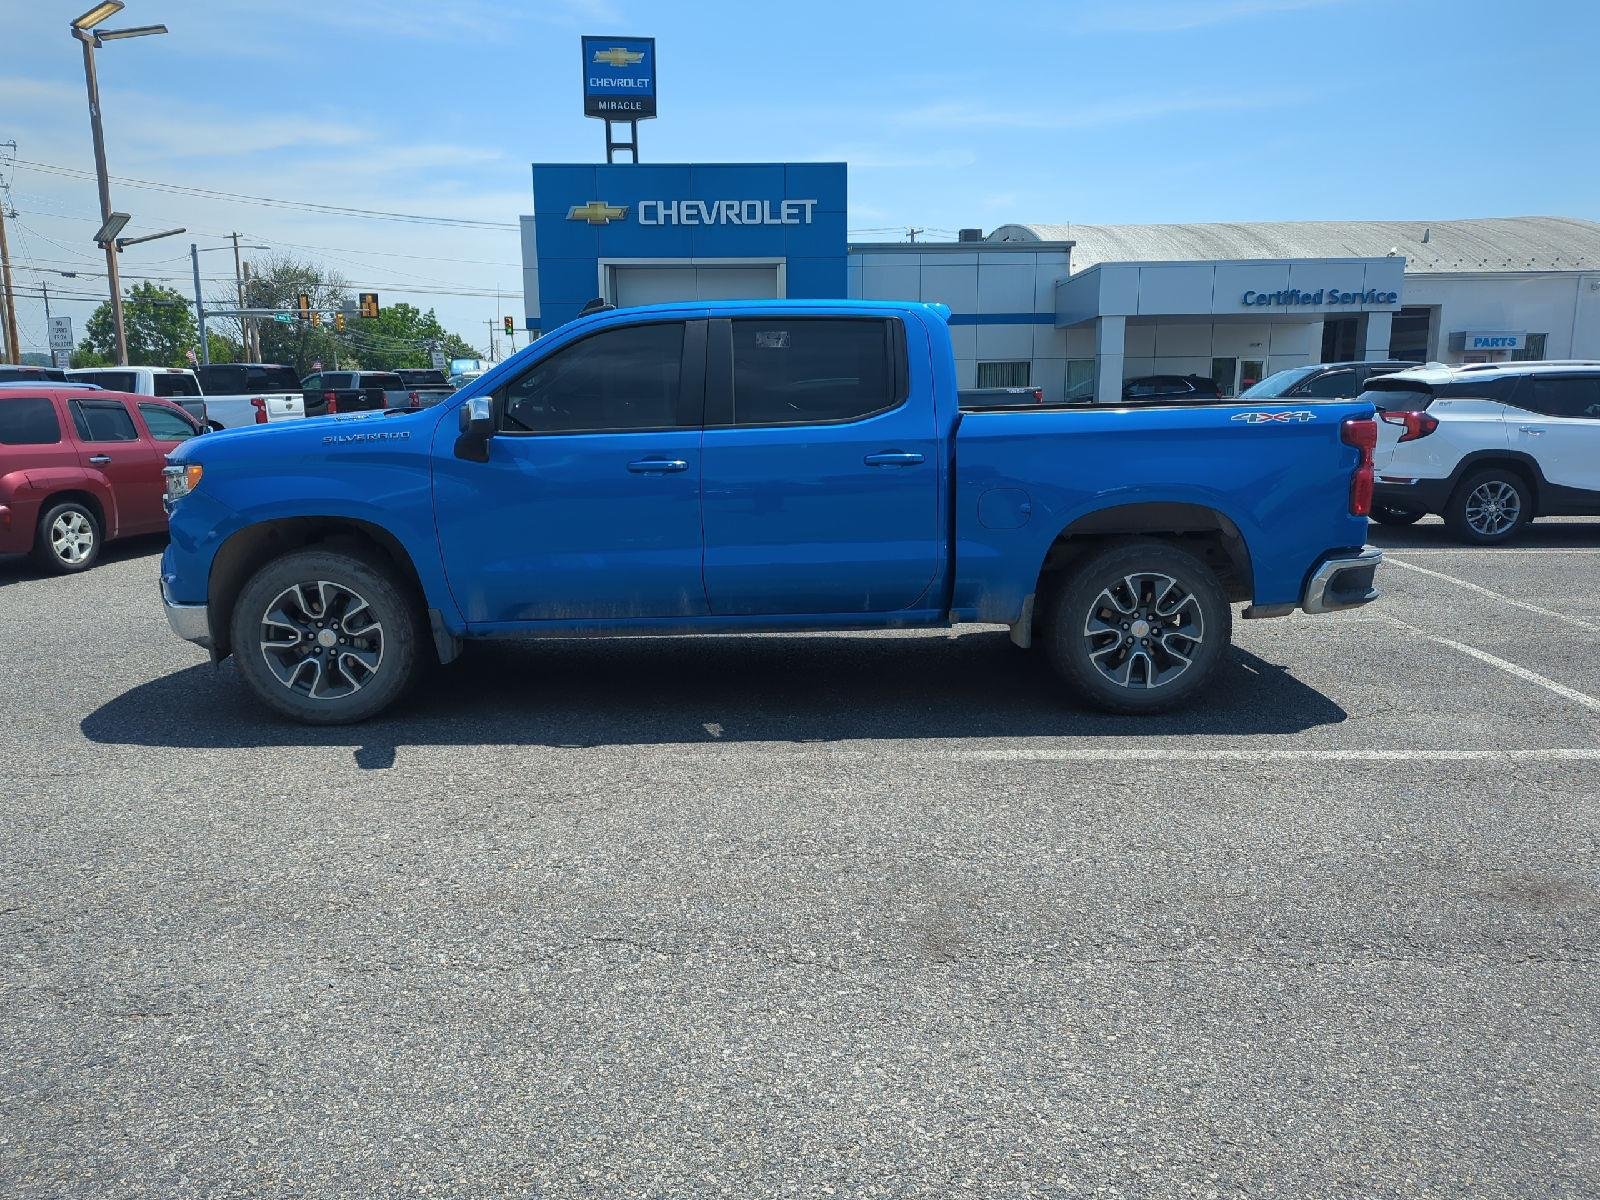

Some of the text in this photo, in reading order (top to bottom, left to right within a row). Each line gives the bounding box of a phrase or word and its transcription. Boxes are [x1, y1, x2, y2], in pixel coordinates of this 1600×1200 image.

[590, 78, 650, 88] CHEVROLET
[599, 101, 642, 110] MIRACLE
[638, 200, 818, 225] CHEVROLET
[1243, 288, 1398, 306] Certified Service
[1474, 337, 1517, 348] PARTS
[323, 431, 410, 443] SILVERADO
